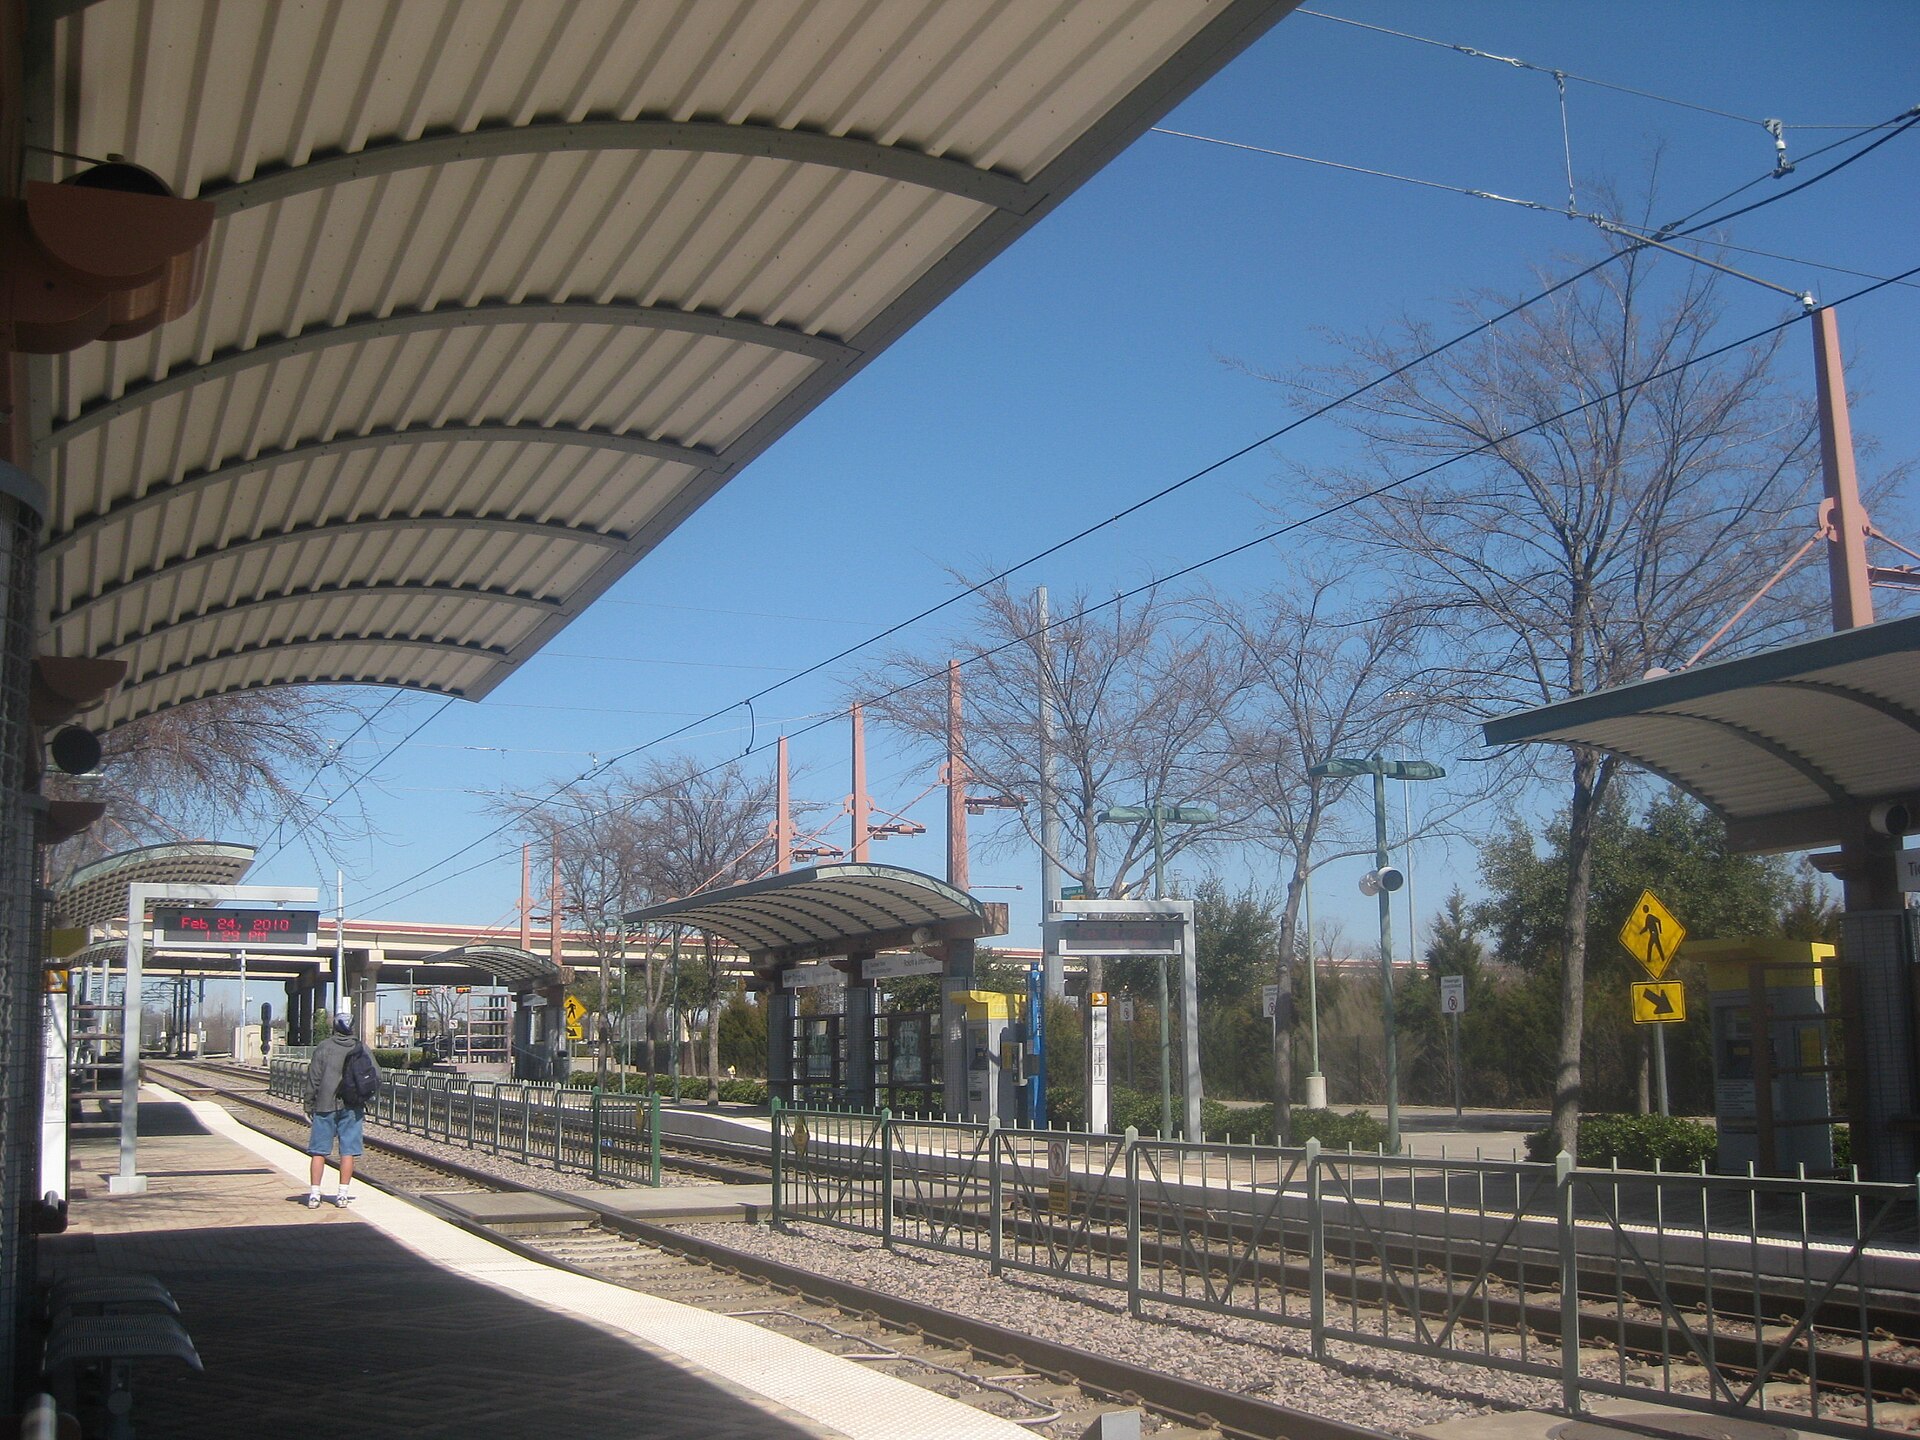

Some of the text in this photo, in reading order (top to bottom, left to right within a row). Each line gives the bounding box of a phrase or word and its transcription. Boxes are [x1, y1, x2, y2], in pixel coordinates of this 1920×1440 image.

[181, 917, 290, 931] Feb 24, 2010
[205, 931, 267, 942] 1:29 PM
[404, 1016, 413, 1025] W
